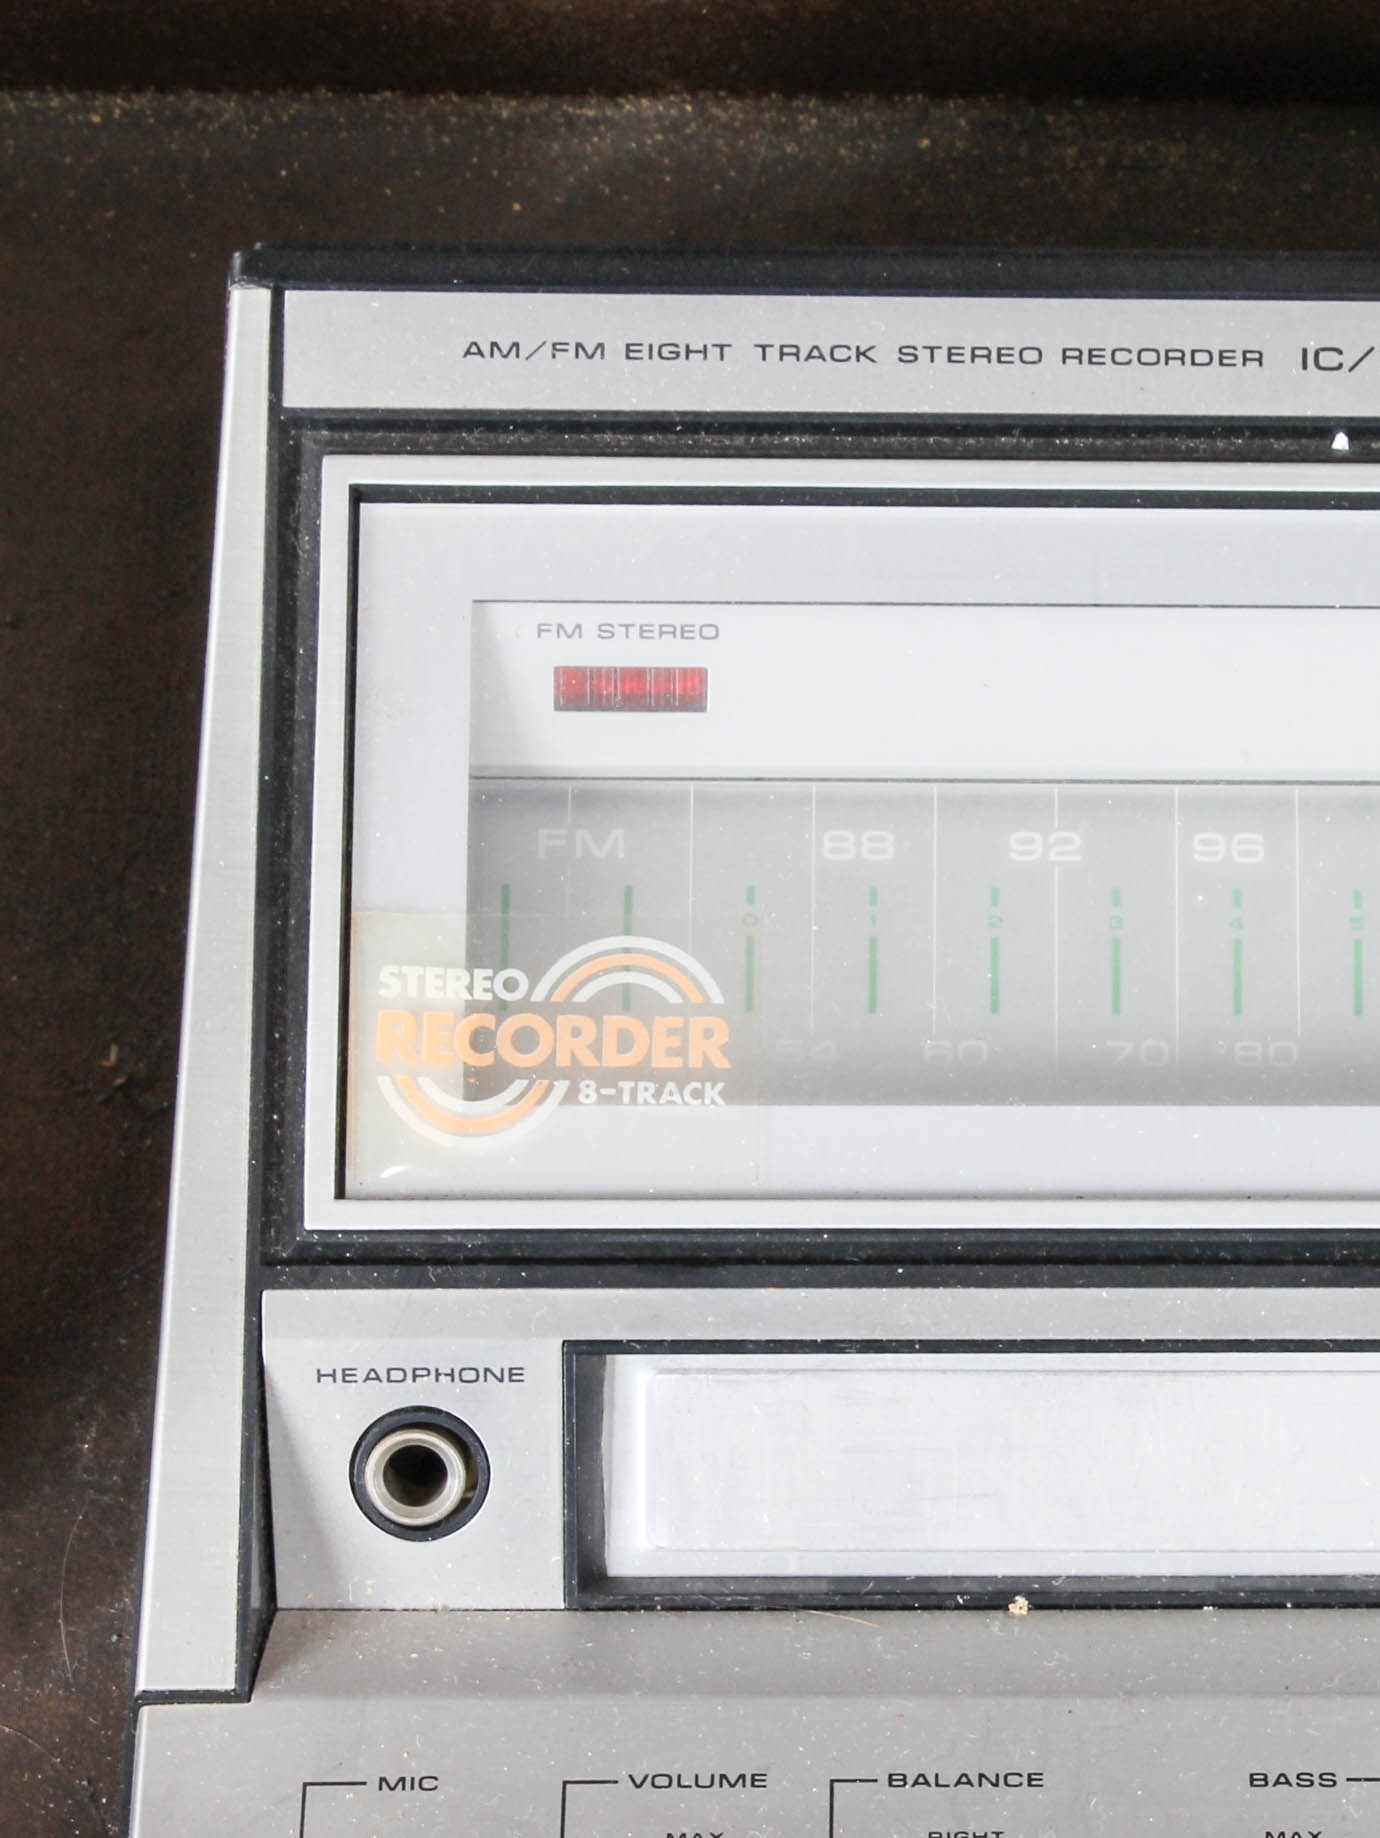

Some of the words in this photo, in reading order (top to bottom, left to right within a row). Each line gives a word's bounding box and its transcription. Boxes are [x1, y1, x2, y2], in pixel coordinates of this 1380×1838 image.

[462, 340, 606, 361] AM/FM
[624, 342, 733, 362] EIGHT
[753, 343, 877, 364] TRACK
[897, 344, 1043, 365] STEREO
[1061, 347, 1264, 368] RECORDER
[536, 622, 583, 640] FM
[597, 622, 720, 641] STEREO
[536, 828, 626, 860] FM
[823, 830, 895, 861] 88
[1009, 831, 1082, 862] 92
[1192, 832, 1265, 864] 96
[1109, 915, 1124, 930] 3
[1228, 915, 1244, 931] 4
[378, 965, 529, 1001] STEREO
[375, 1010, 732, 1070] RECORDER
[923, 1040, 989, 1065] 60
[1106, 1040, 1168, 1066] 70
[1233, 1040, 1298, 1066] 80
[577, 1080, 727, 1106] 8-TRACK
[316, 1366, 525, 1384] HEADPHONE
[378, 1775, 439, 1792] MIC
[627, 1773, 768, 1790] VOLUME
[887, 1772, 1044, 1788] BALANCE
[1248, 1771, 1338, 1788] BASS
